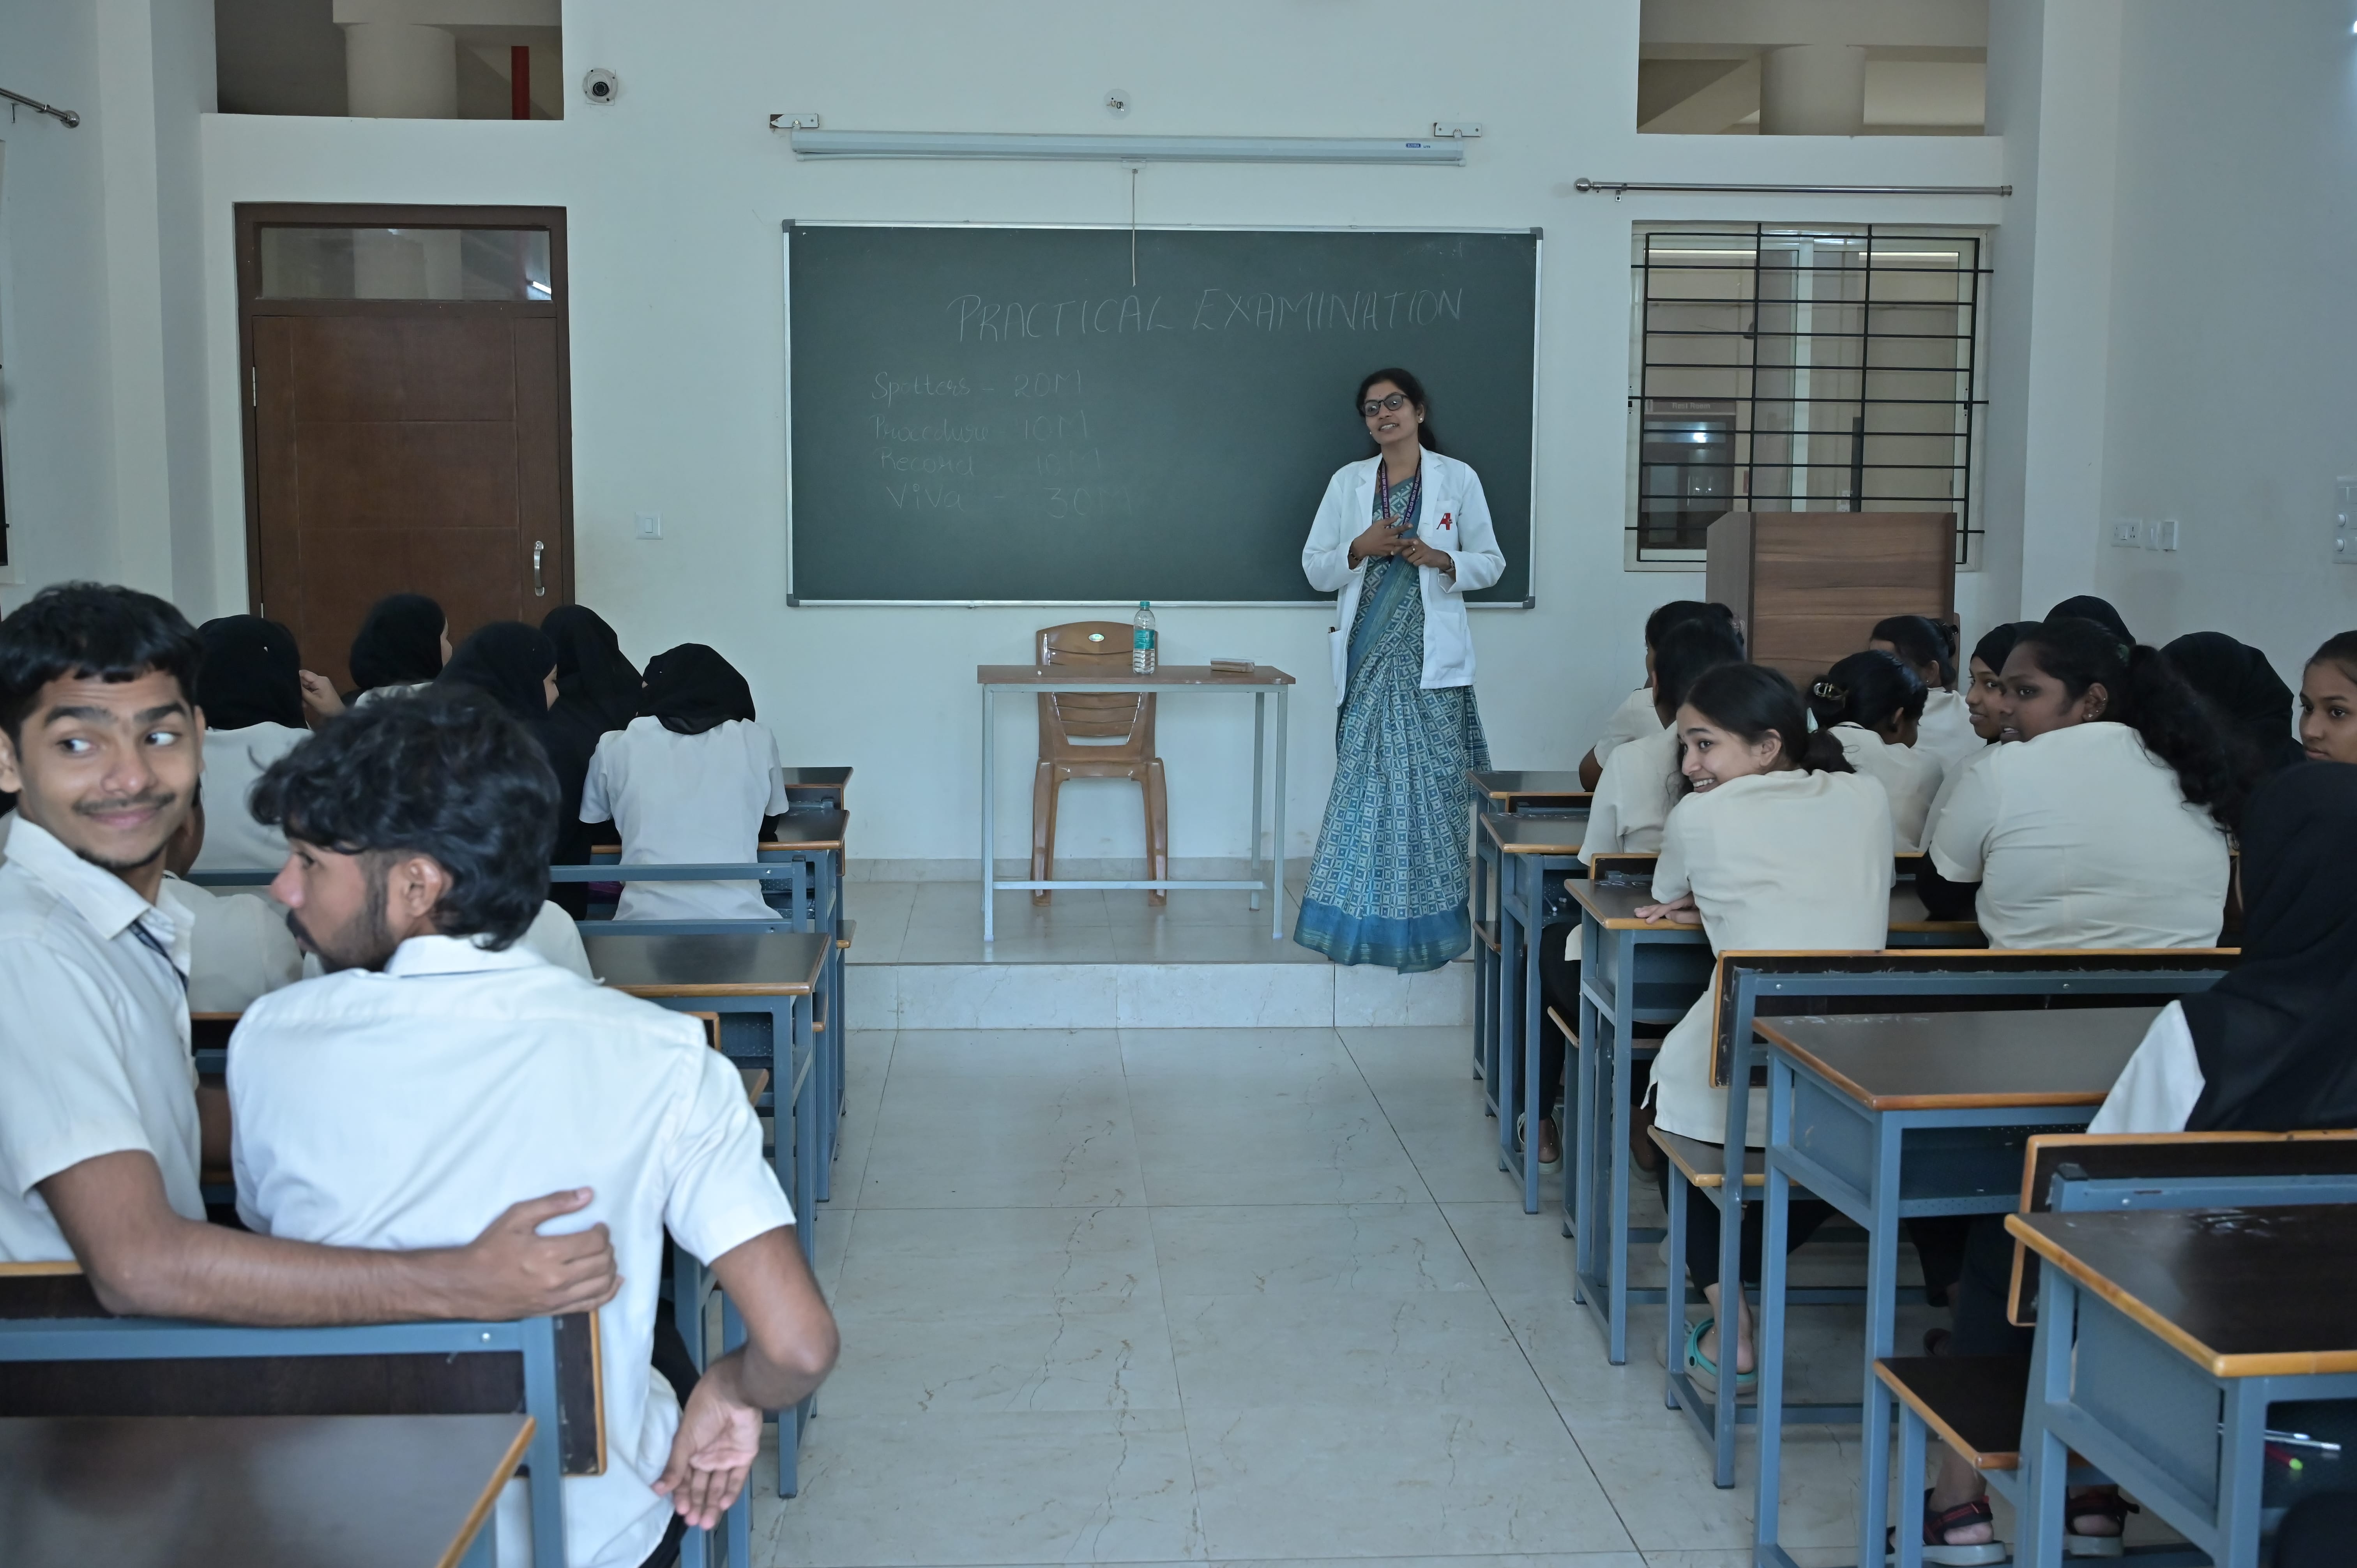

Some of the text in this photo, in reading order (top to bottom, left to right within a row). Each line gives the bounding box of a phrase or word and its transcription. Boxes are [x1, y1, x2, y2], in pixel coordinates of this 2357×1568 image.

[947, 288, 1462, 342] PRACTICAL EXAMINATION
[872, 371, 971, 407] Spotters
[1014, 369, 1081, 397] 20M
[1025, 409, 1088, 441] 10M
[873, 446, 975, 477] Record
